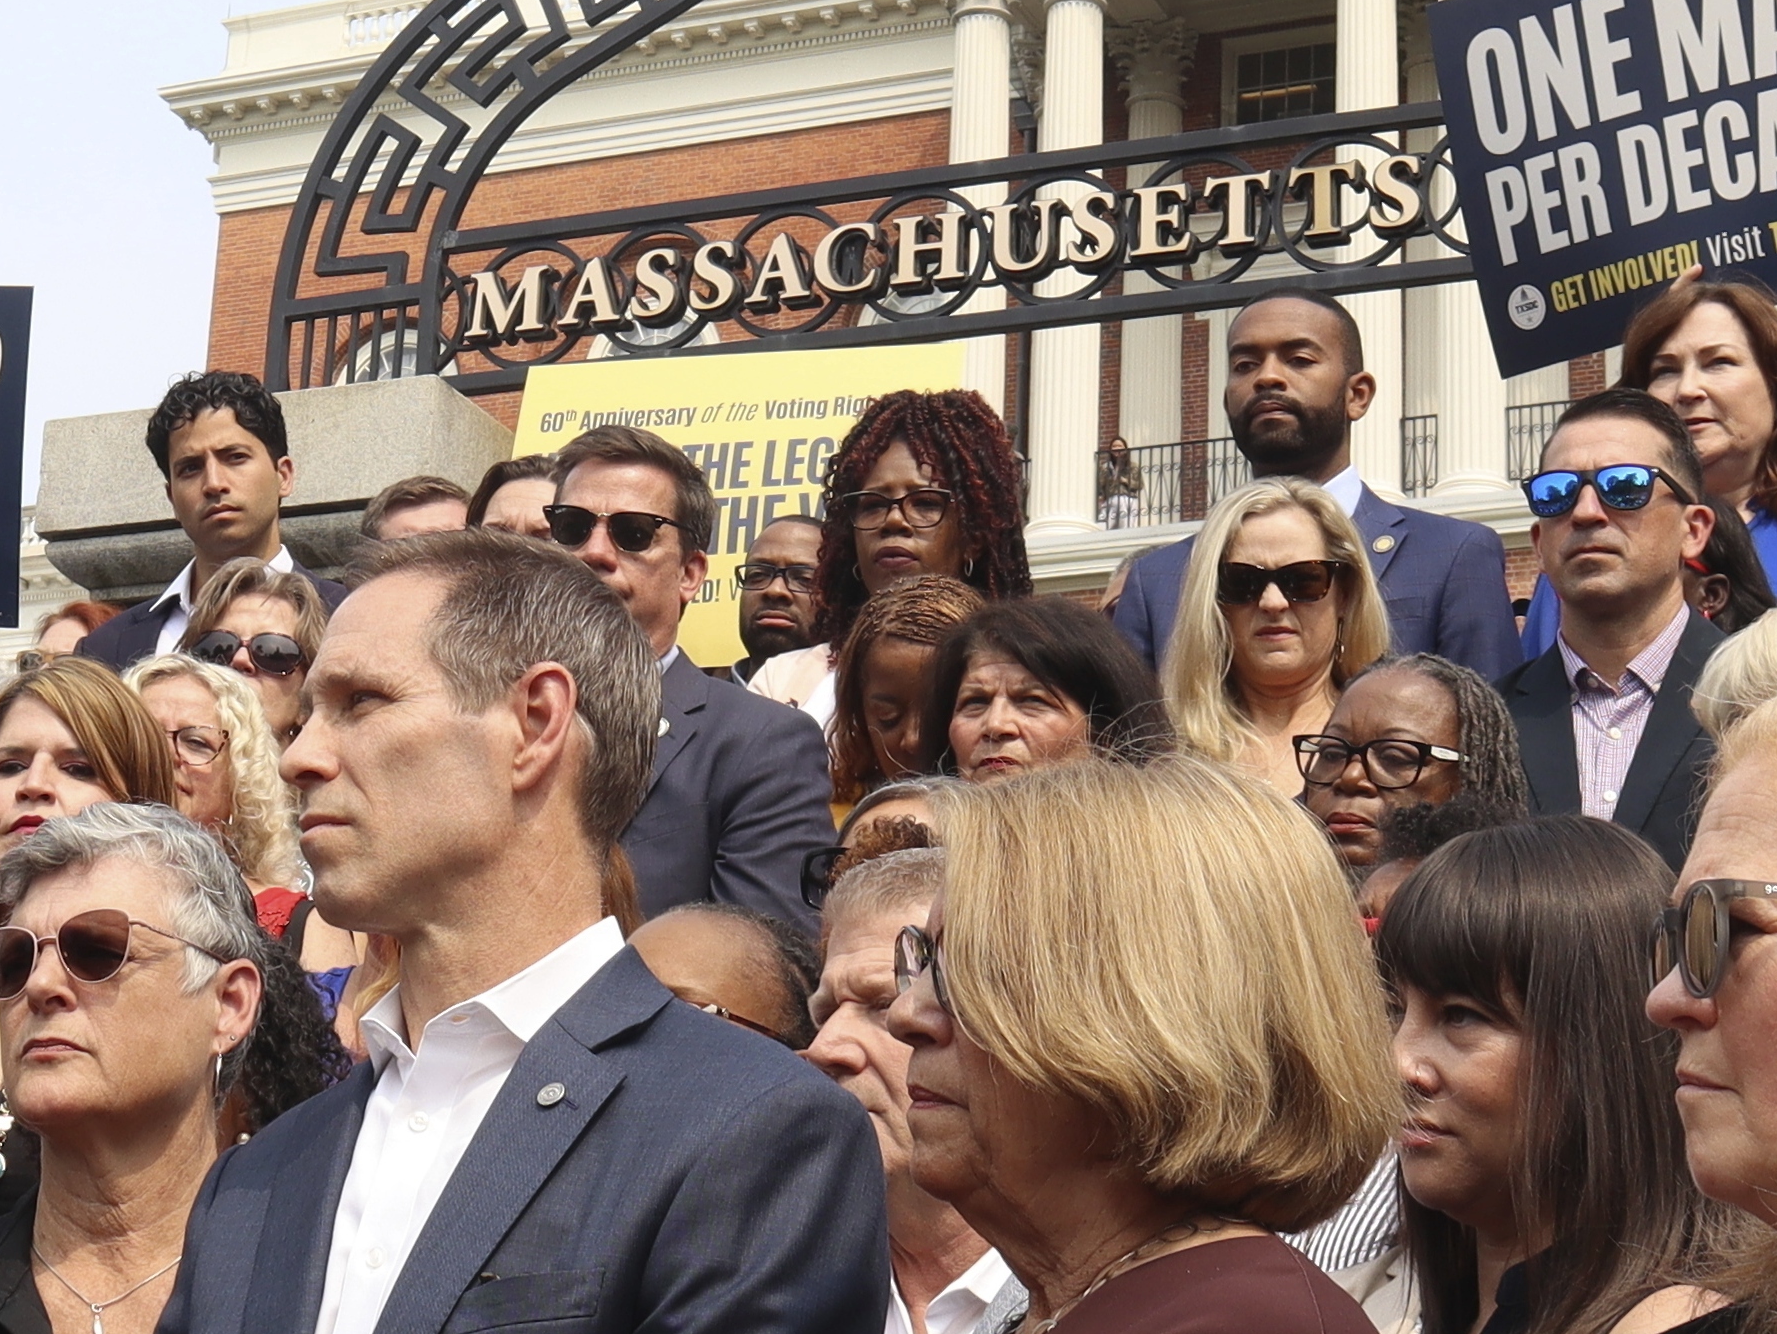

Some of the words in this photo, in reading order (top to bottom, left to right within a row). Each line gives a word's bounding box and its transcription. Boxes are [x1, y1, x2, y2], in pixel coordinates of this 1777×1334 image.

[1484, 141, 1613, 267] PER
[464, 152, 1422, 343] MASSACHUSETTS
[1550, 274, 1588, 314] GET
[1590, 239, 1702, 302] INVOLVED!
[1705, 226, 1766, 267] Visit
[540, 409, 577, 433] 60th
[579, 407, 697, 431] Anniversary
[701, 402, 725, 424] of
[725, 401, 759, 423] the
[765, 397, 828, 420] Voting
[682, 441, 754, 491] THE
[706, 493, 787, 556] THE
